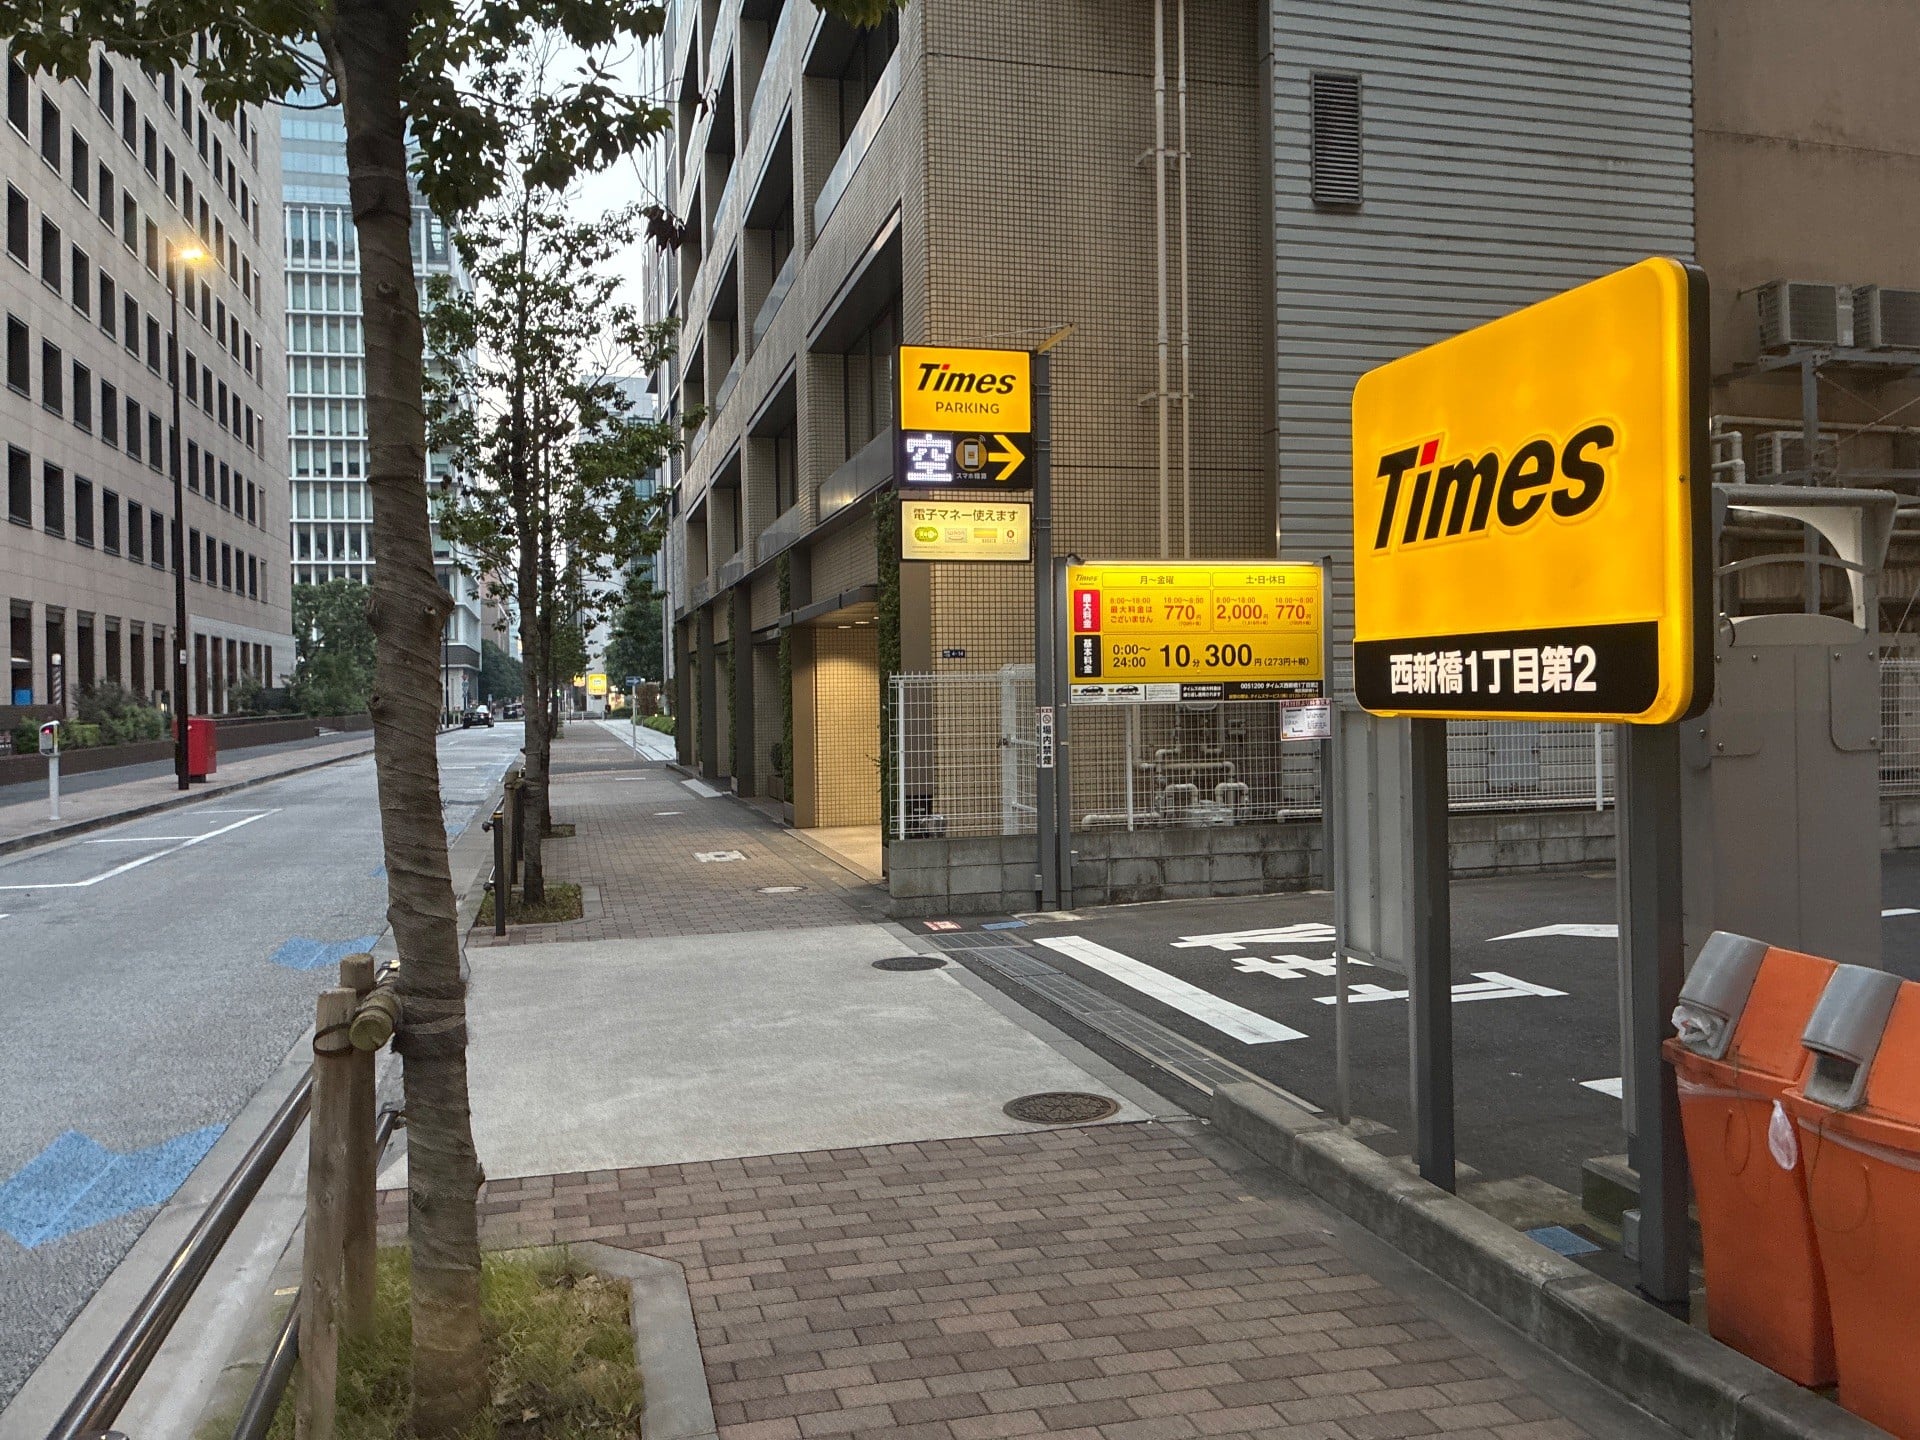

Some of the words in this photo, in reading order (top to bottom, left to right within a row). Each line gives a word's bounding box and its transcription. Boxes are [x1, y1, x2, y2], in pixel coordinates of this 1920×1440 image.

[917, 363, 1016, 394] Times
[935, 401, 1000, 414] PARKING
[907, 434, 952, 482] 空
[1373, 424, 1615, 550] Times
[913, 508, 1018, 521] 電子マネー使えます
[1140, 575, 1174, 585] 月～金曜
[1110, 615, 1154, 624] ございません
[1083, 638, 1093, 674] 基本料金
[1113, 656, 1146, 668] 24:00
[1389, 645, 1598, 694] 西新橋1丁目第2
